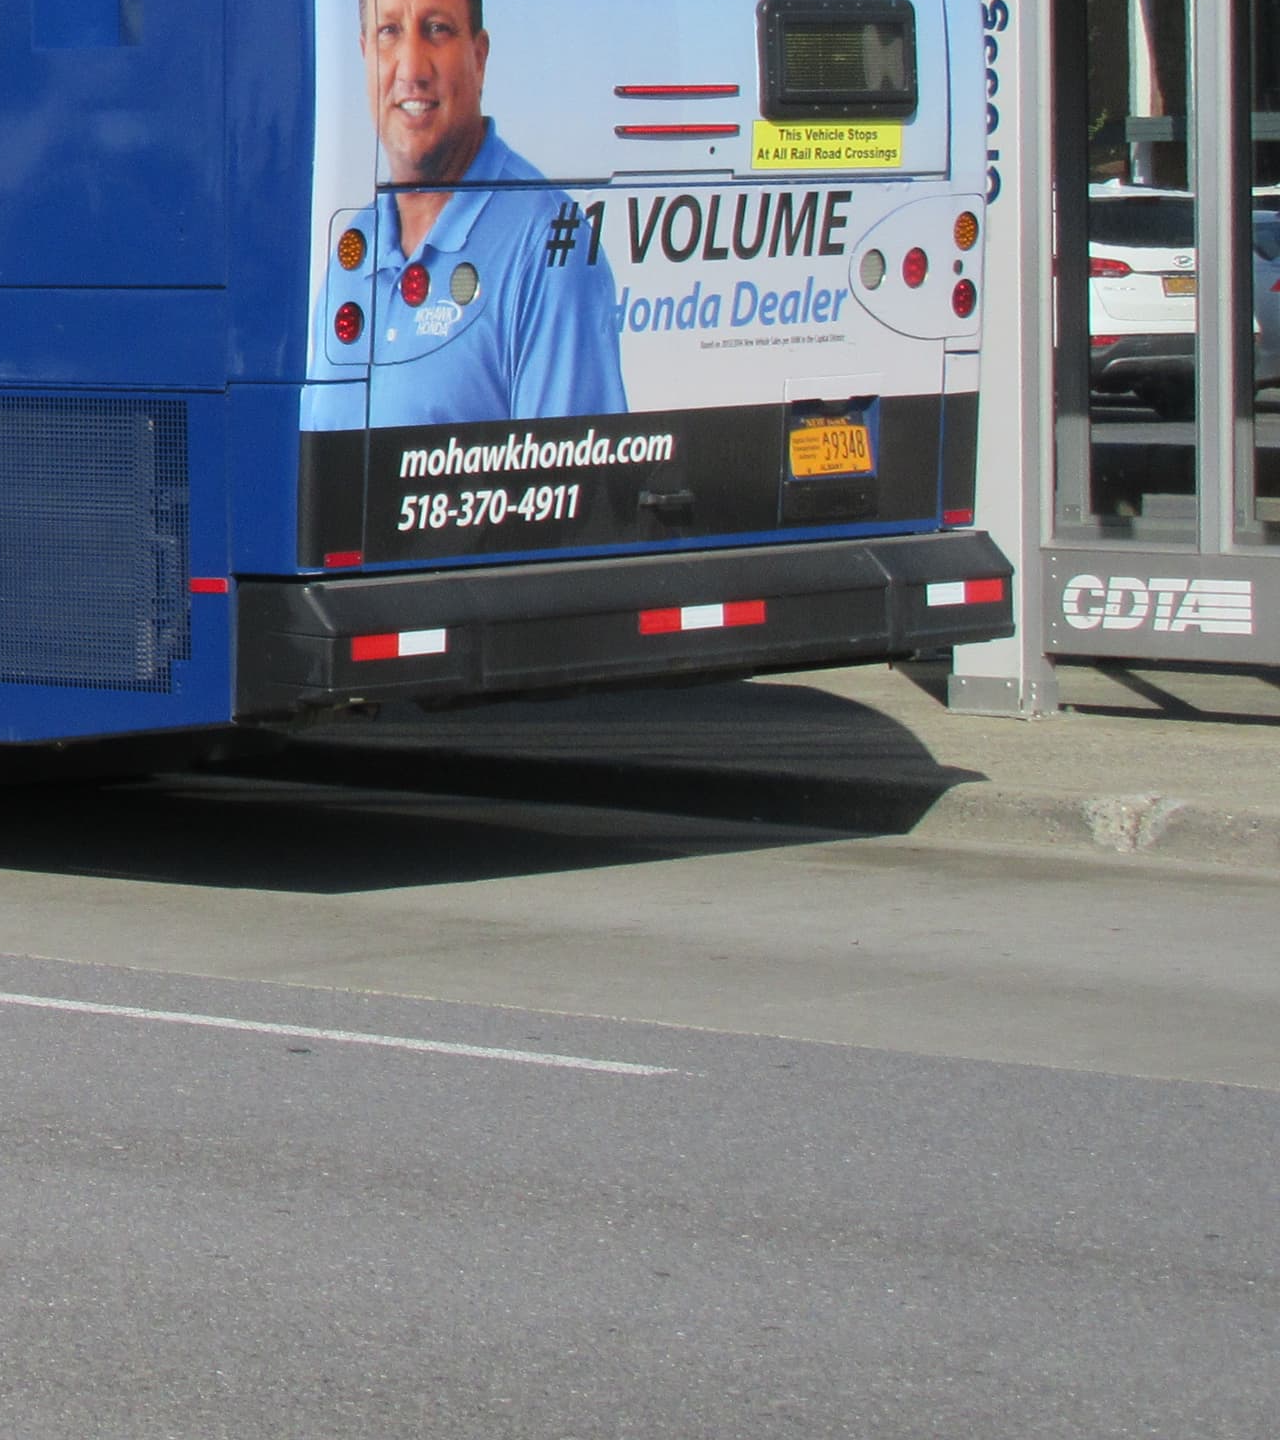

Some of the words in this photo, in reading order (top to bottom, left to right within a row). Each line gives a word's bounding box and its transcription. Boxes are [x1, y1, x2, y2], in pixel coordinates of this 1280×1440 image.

[756, 147, 770, 160] At
[772, 147, 788, 160] All
[790, 147, 812, 160] Rail
[814, 147, 842, 160] Road
[844, 146, 898, 161] Crossings
[778, 128, 802, 141] This
[805, 128, 844, 140] Vehicle
[847, 128, 878, 142] Stops
[545, 201, 605, 267] #1
[627, 191, 853, 264] VOLUME
[730, 276, 849, 328] Dealer
[399, 429, 673, 479] mohawkhonda.com
[830, 429, 865, 460] 9348
[397, 484, 581, 531] 518-370-4911
[1062, 574, 1253, 635] CDTA
